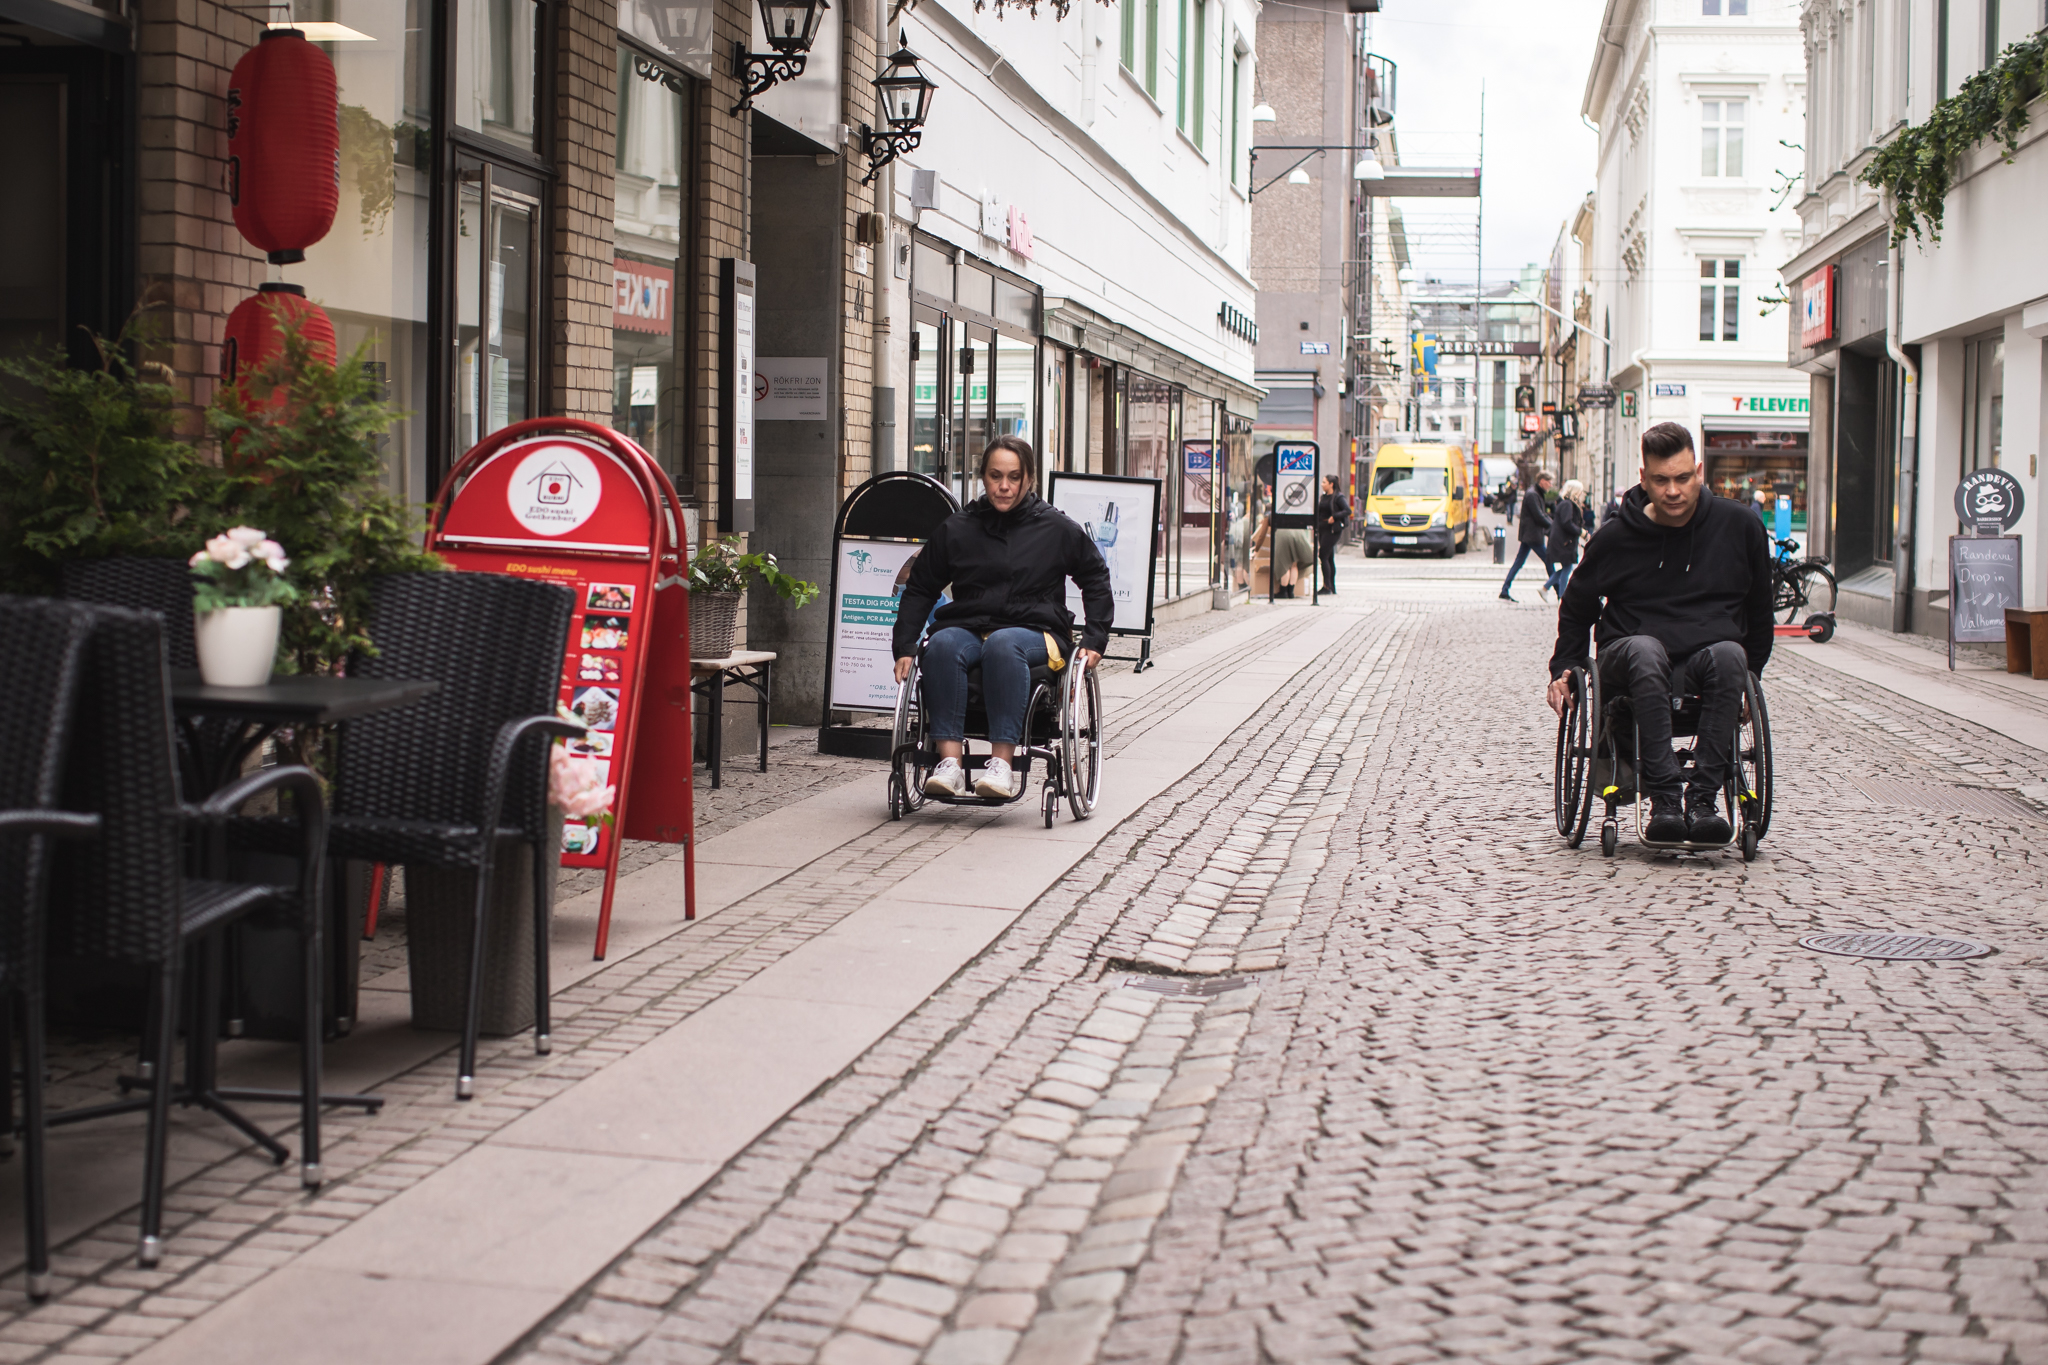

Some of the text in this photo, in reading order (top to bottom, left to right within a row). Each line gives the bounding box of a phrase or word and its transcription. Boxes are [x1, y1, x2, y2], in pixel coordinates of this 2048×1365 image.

[773, 376, 821, 385] RÖKFRI ZON
[1963, 473, 2016, 491] RANDEVU
[529, 506, 549, 514] EDO
[525, 513, 577, 523] Gothenburg
[1959, 546, 2013, 562] Randevu
[506, 563, 578, 576] EDO sushi menu
[1960, 567, 2005, 586] Drop in
[844, 597, 865, 606] TESTA
[879, 599, 894, 607] FÖR
[843, 614, 866, 622] Antigen,
